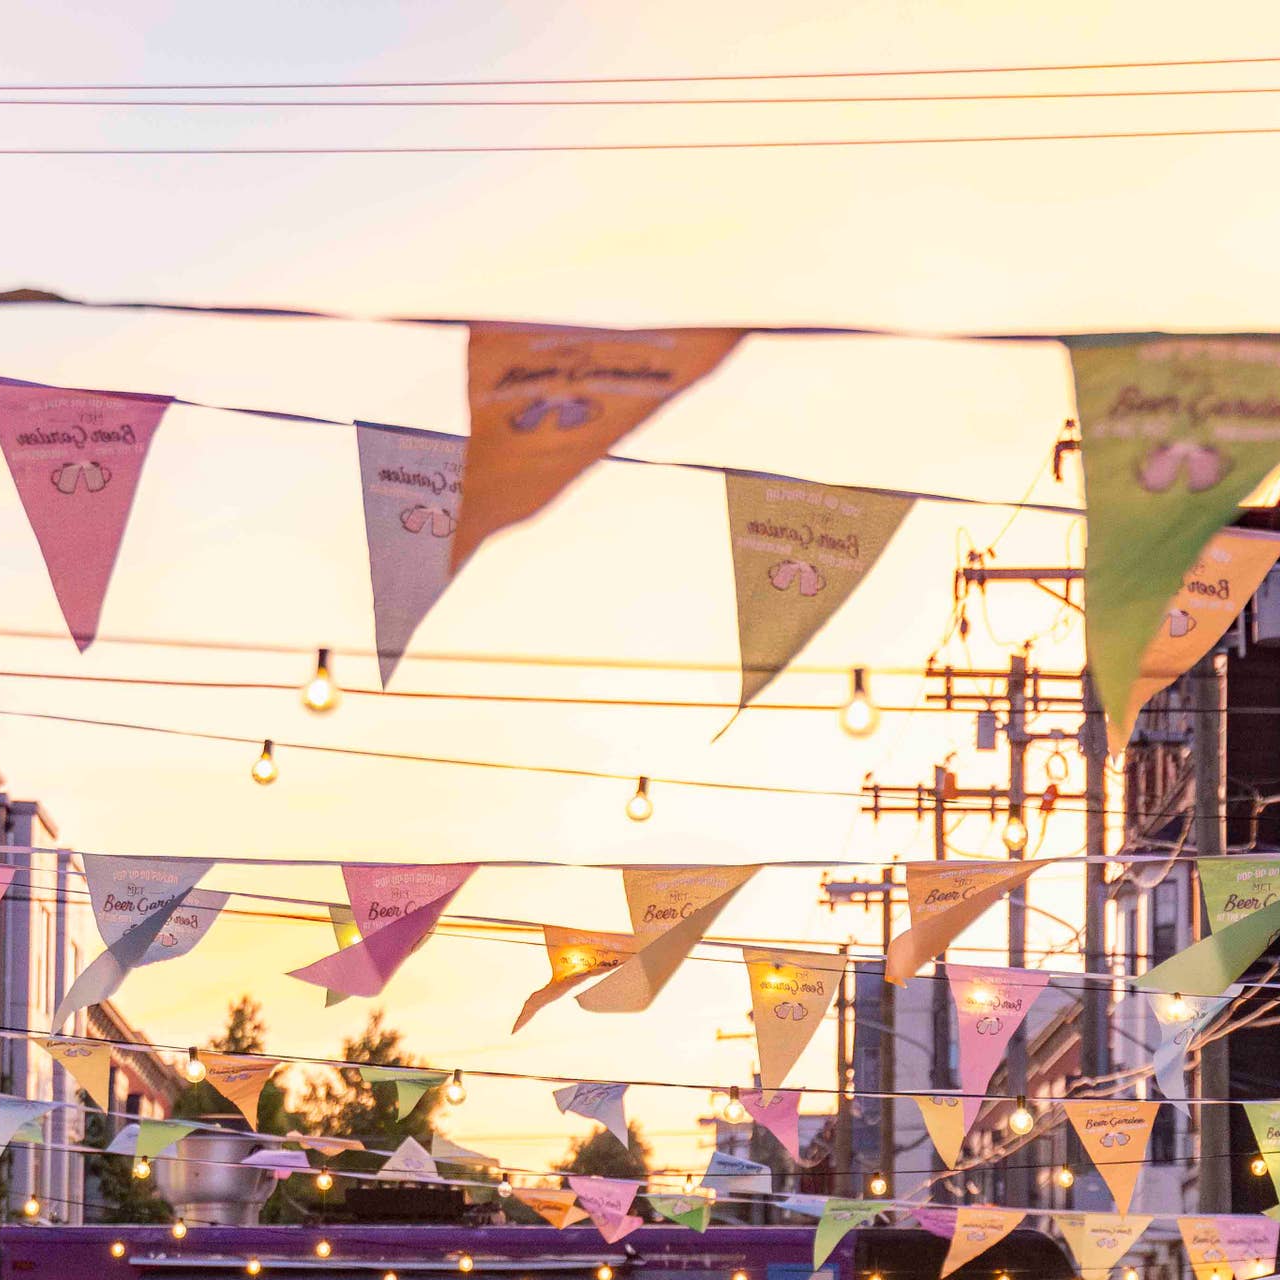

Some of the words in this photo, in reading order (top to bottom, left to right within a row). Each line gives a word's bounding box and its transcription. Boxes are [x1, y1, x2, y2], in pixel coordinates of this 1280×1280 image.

[103, 894, 136, 912] Beer
[924, 887, 961, 905] Beer
[1224, 893, 1262, 912] Beer
[368, 901, 402, 921] Beer
[642, 904, 678, 924] Beer
[1085, 1118, 1108, 1130] Beer
[1109, 1116, 1145, 1128] Garden
